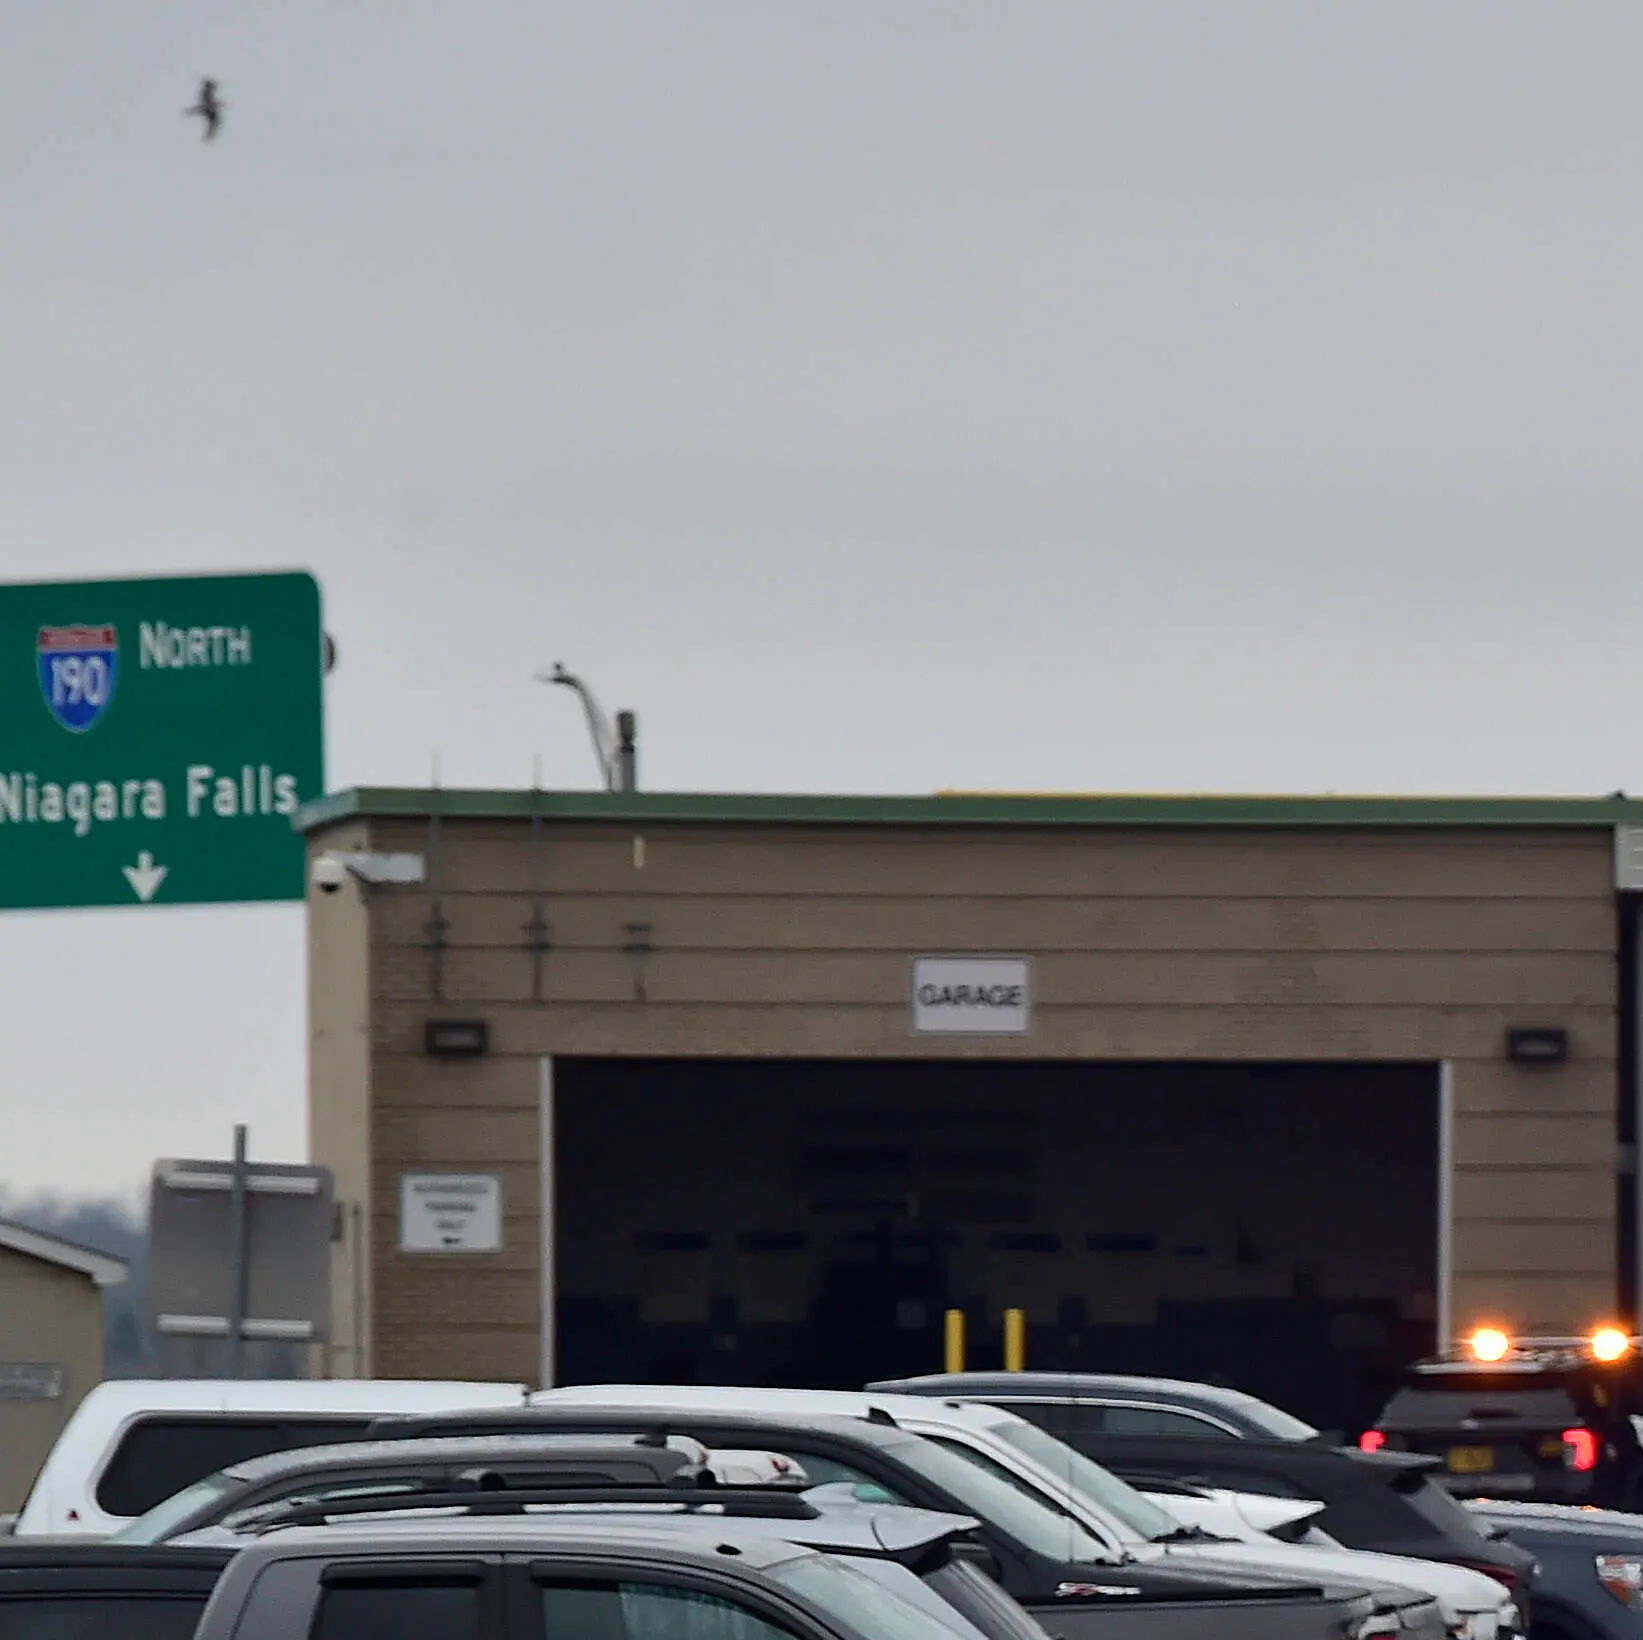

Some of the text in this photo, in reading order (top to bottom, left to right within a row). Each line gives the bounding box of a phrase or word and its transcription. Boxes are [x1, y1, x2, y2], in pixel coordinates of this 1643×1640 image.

[51, 655, 107, 705] 190
[0, 763, 299, 837] Niagara Falls
[918, 983, 1022, 1007] GARAGE
